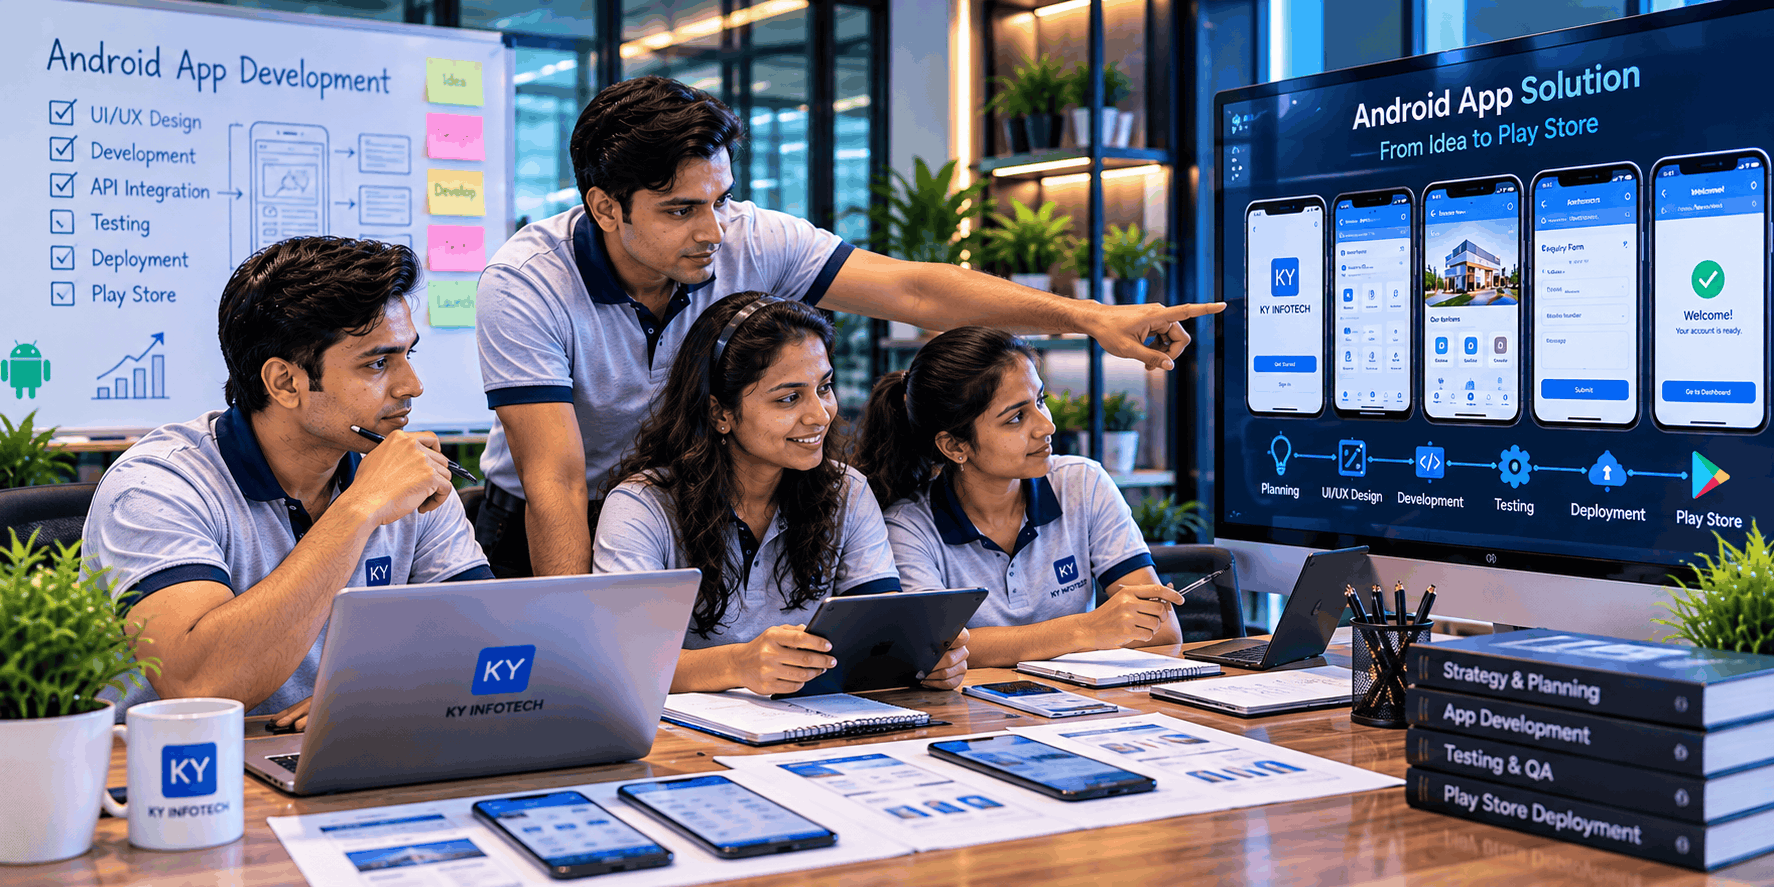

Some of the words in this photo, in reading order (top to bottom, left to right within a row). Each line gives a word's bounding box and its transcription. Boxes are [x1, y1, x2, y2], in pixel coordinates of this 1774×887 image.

[47, 38, 161, 78] Android
[176, 49, 227, 93] App
[240, 55, 391, 100] Development
[1352, 89, 1450, 130] Android
[1458, 86, 1513, 118] App
[1520, 64, 1640, 104] Solution
[91, 105, 143, 126] UI/UX
[150, 109, 202, 135] Design
[1380, 140, 1423, 160] From
[1429, 132, 1467, 154] Idea
[1473, 129, 1492, 148] to
[1499, 122, 1539, 146] Play
[1544, 116, 1599, 139] Store
[91, 141, 196, 168] Development
[90, 177, 118, 196] API
[125, 180, 210, 203] Integration
[434, 182, 476, 201] Develop
[90, 213, 150, 238] Testing
[92, 248, 189, 273] Deployment
[1275, 268, 1295, 287] KY
[92, 284, 126, 309] Play
[132, 285, 176, 303] Store
[1259, 305, 1270, 314] KY
[1271, 304, 1311, 315] INFOTECH
[1683, 309, 1733, 321] Welcome!
[1675, 327, 1689, 335] Your
[1690, 327, 1715, 335] account
[1574, 386, 1594, 394] Submit
[1261, 482, 1300, 499] Planning
[1321, 486, 1349, 500] UI/UX
[1351, 488, 1383, 504] Design
[1397, 491, 1464, 508] Development
[1494, 498, 1534, 516] Testing
[1571, 503, 1646, 522] Deployment
[1676, 510, 1703, 528] Play
[1706, 512, 1743, 528] Store
[370, 564, 388, 581] KY
[1059, 562, 1074, 578] KY
[1050, 589, 1060, 598] KY
[483, 658, 525, 682] KY
[1443, 661, 1509, 690] Strategy
[1511, 670, 1524, 690] &
[1528, 673, 1601, 705] Planning
[446, 705, 467, 718] KY
[469, 699, 545, 716] INFOTECH
[1443, 703, 1477, 728] App
[1480, 708, 1591, 745] Development
[170, 756, 210, 785] KY
[1444, 743, 1504, 775] Testing
[1507, 755, 1521, 775] &
[1525, 759, 1554, 782] QA
[148, 805, 165, 818] KY
[168, 802, 230, 818] INFOTECH
[1444, 785, 1478, 812] Play
[1482, 792, 1528, 819] Store
[1532, 803, 1643, 845] Deployment
